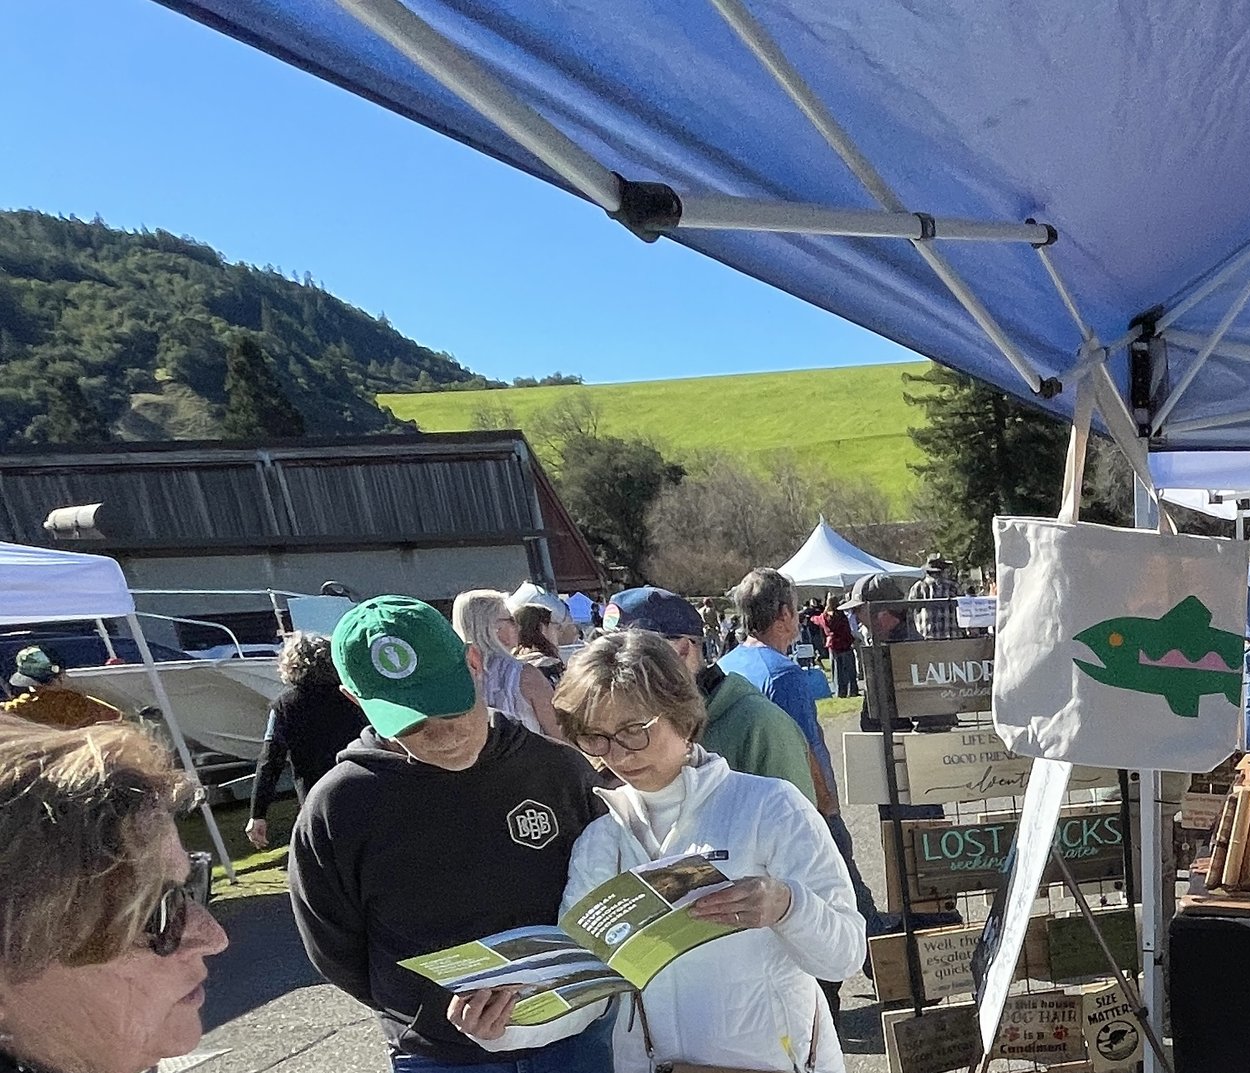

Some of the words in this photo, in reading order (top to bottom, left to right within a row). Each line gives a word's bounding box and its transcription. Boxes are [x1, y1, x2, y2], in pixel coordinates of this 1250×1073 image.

[910, 660, 995, 686] LAUNDR
[961, 733, 985, 746] LIFE
[980, 748, 1021, 763] FRIEND
[922, 825, 1005, 862] LOST
[1051, 816, 1123, 848] OCKS
[926, 950, 974, 967] escalat
[934, 962, 972, 980] quick
[1040, 999, 1077, 1010] house
[1095, 993, 1118, 1009] SIZE
[1039, 1009, 1078, 1023] HAIR
[1087, 1002, 1134, 1026] MATTERS
